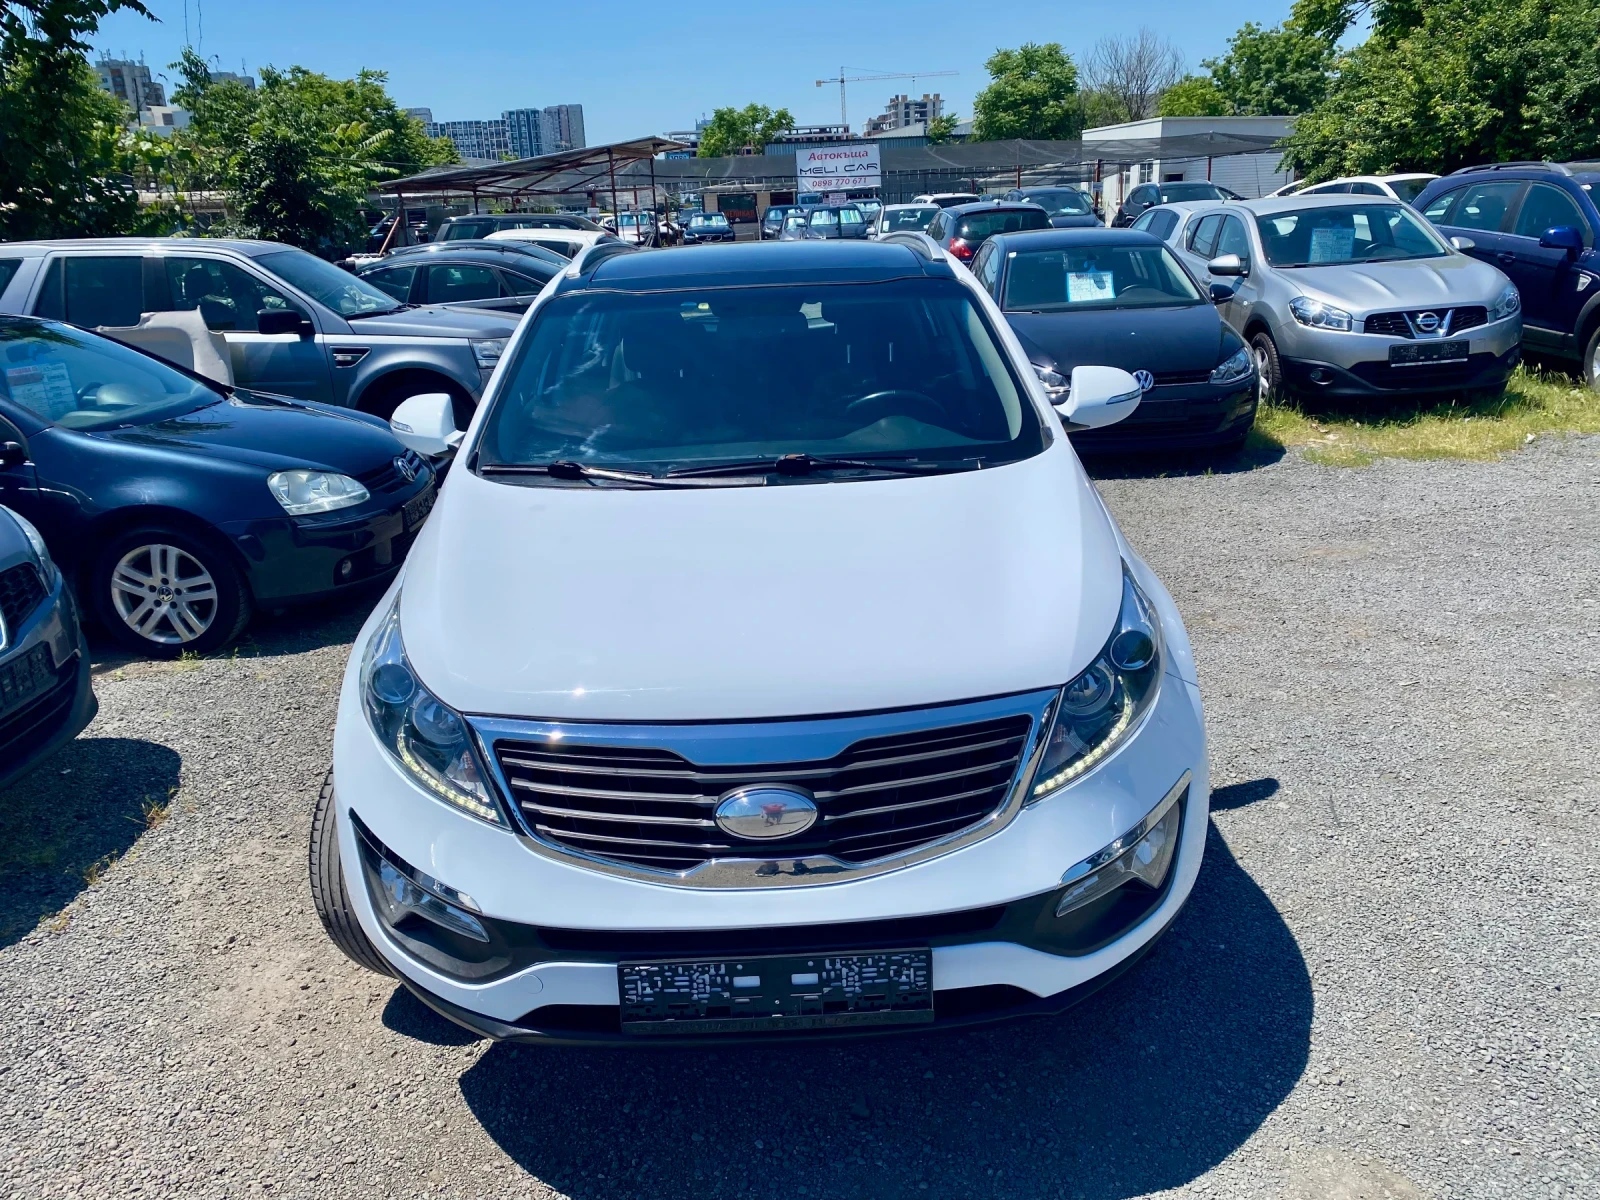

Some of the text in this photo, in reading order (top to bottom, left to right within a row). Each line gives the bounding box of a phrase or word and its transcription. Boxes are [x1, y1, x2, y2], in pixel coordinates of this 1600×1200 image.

[808, 150, 869, 161] Автокъща
[799, 163, 878, 175] MELI CAR
[812, 177, 867, 187] 0898 770 671
